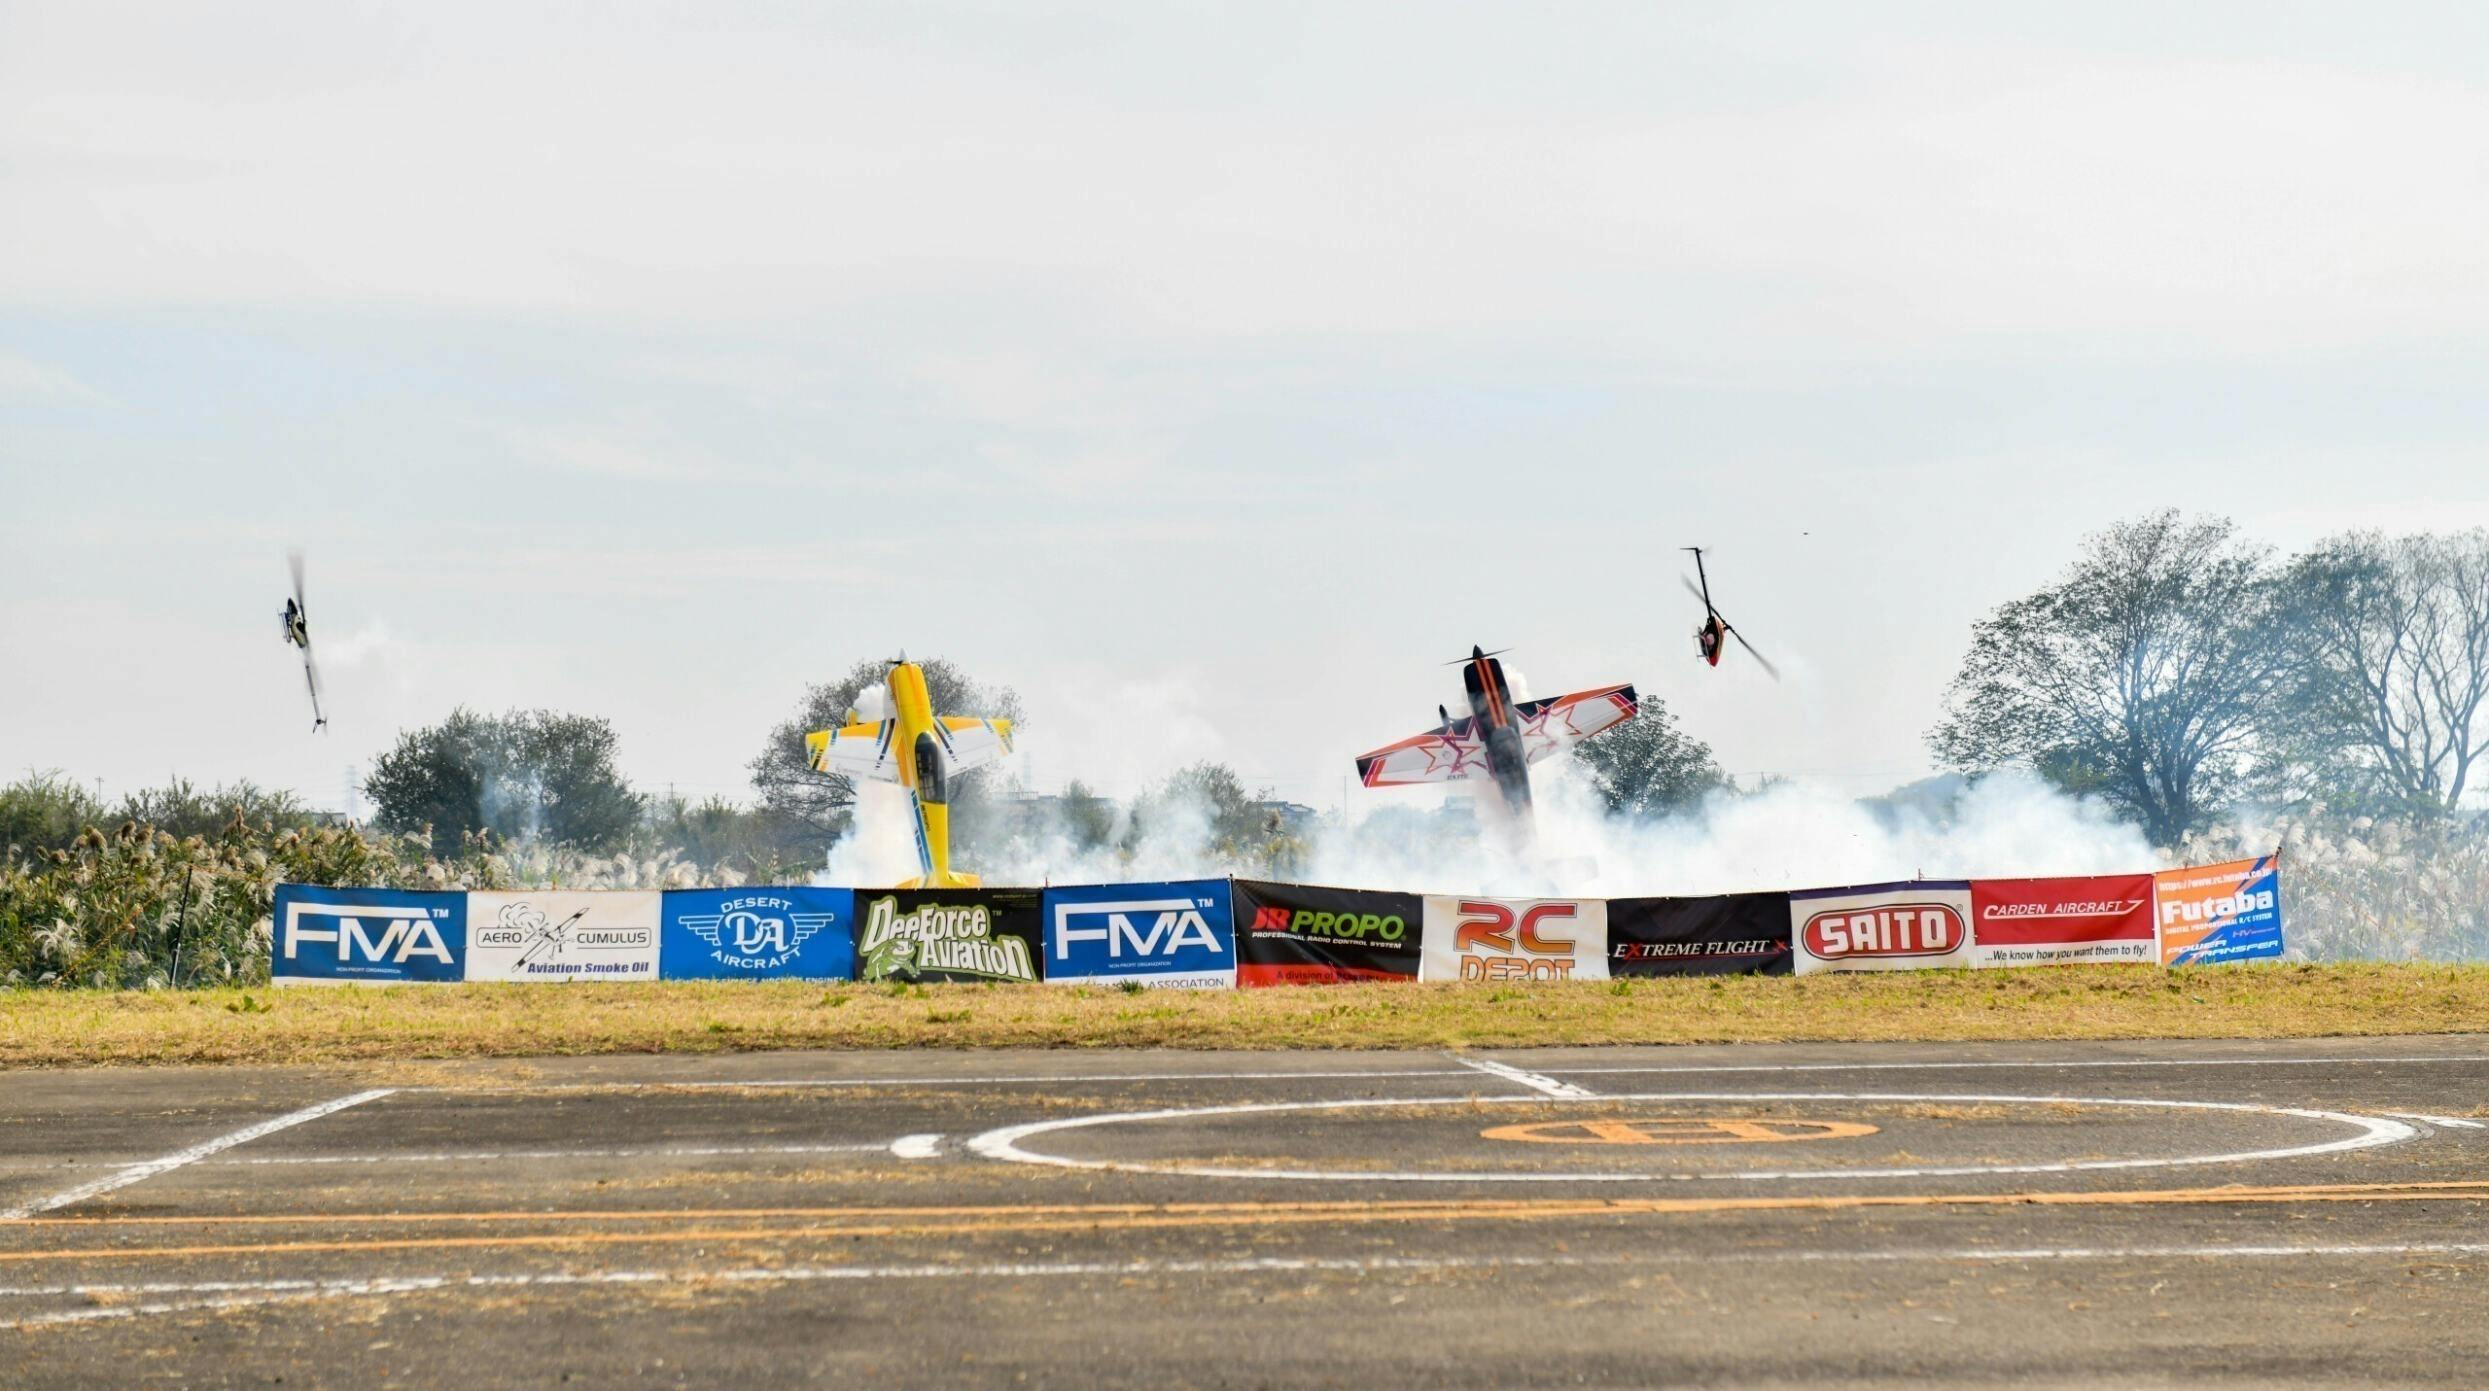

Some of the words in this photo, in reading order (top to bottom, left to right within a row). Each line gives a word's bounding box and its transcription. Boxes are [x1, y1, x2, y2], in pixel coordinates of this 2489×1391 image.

[720, 897, 793, 914] DESERT
[1983, 903, 2048, 920] CARDEN
[2053, 901, 2122, 913] AIRCRAFT
[2161, 890, 2274, 925] Futaba
[1251, 906, 1291, 930] JR
[1291, 910, 1404, 941] PROPO
[1454, 900, 1577, 955] RC
[2239, 915, 2251, 924] R/C
[2252, 912, 2273, 922] SYSTEM
[285, 902, 454, 964] FMA
[482, 932, 522, 944] AERO
[577, 932, 647, 944] CUMULUS
[725, 912, 790, 954] DA
[1055, 899, 1223, 960] FMA
[1197, 898, 1214, 907] TM
[1819, 911, 1947, 953] SAITO
[1252, 932, 1305, 942] PROFESSIONAL
[1307, 936, 1331, 944] RADIO
[1332, 938, 1367, 946] CONTROL
[1370, 941, 1402, 949] SYSTEM
[1613, 941, 1703, 959] EXTREME
[1706, 940, 1770, 954] FLIGHT
[2166, 940, 2228, 955] POWER
[2189, 940, 2279, 959] TRANSFER
[710, 945, 801, 969] AIRCRAFT
[919, 936, 1033, 981] Aviation
[2009, 949, 2034, 960] know
[2036, 949, 2054, 959] how
[2056, 950, 2072, 961] you
[2074, 947, 2094, 957] want
[2095, 945, 2119, 956] them
[2121, 946, 2131, 955] to
[2133, 945, 2147, 957] fly!
[527, 962, 581, 973] Aviation
[585, 963, 629, 973] Smoke
[632, 961, 649, 973] Oil
[1285, 970, 1322, 980] division
[1460, 954, 1575, 981] DEPOT
